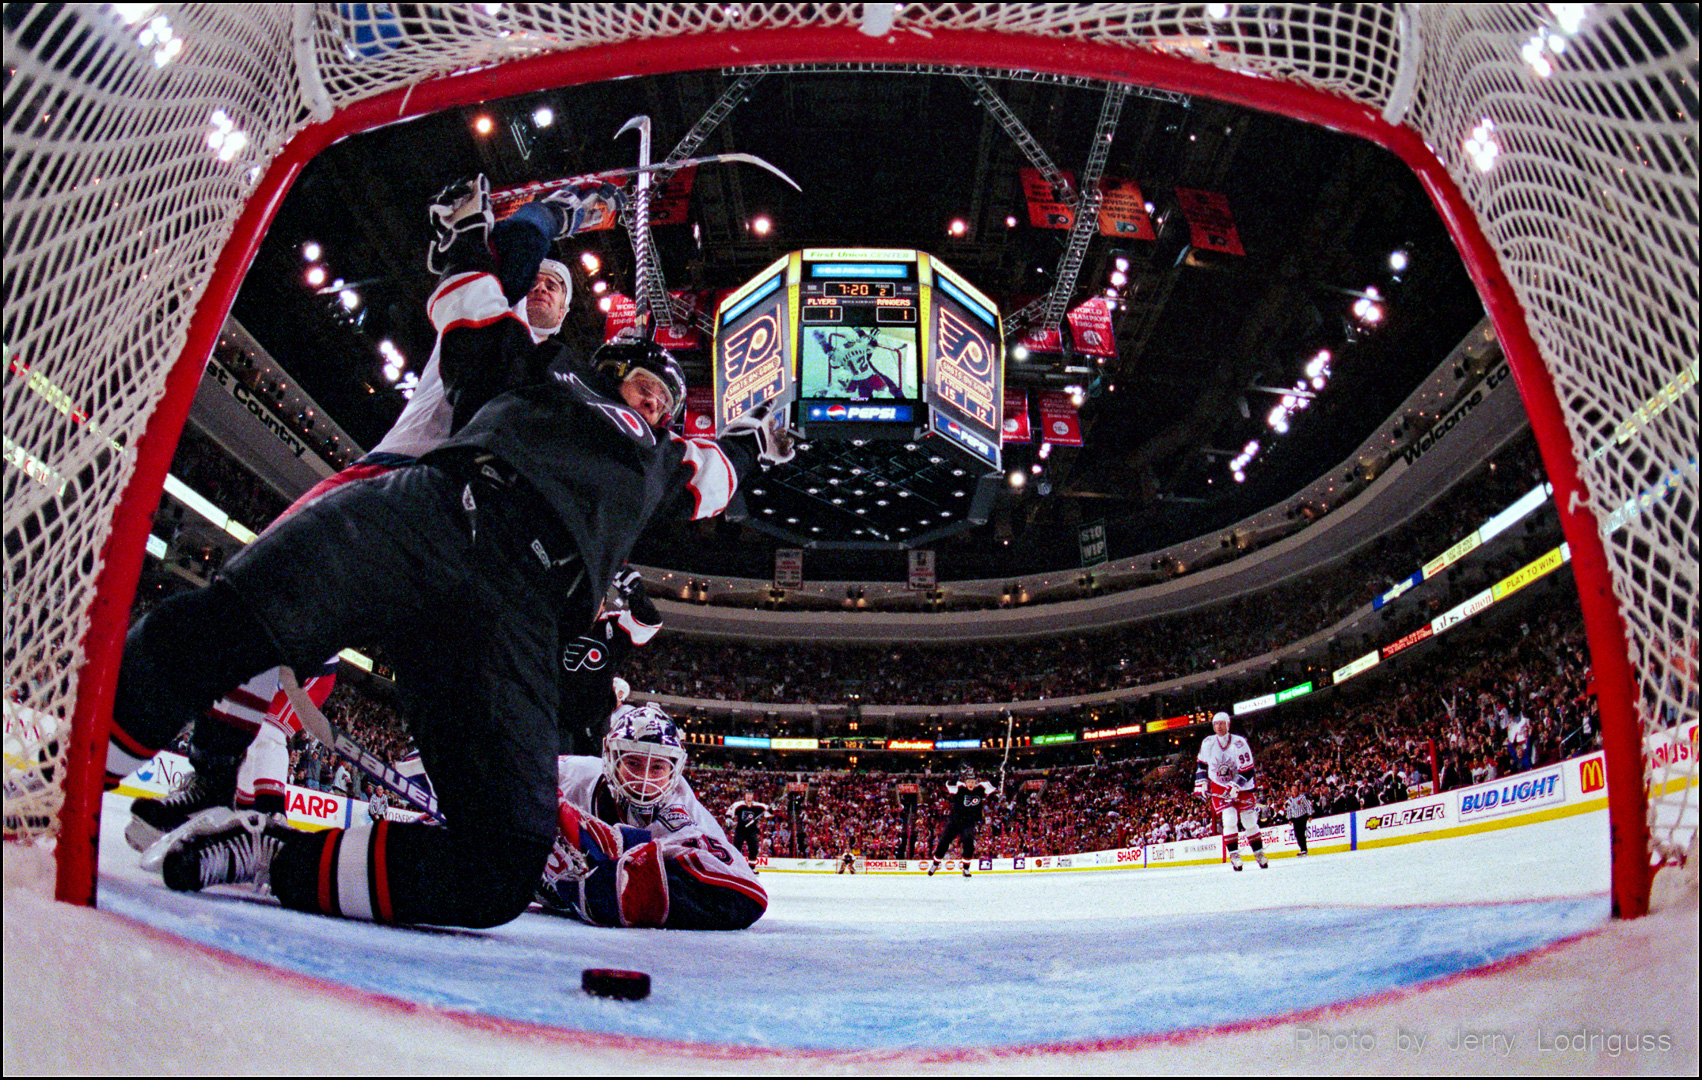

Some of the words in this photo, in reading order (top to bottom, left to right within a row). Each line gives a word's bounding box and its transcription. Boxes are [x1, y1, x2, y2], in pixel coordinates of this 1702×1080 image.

[839, 284, 868, 295] 7:20
[880, 288, 886, 296] 2
[763, 385, 774, 400] 12
[945, 386, 956, 400] 15
[732, 405, 743, 418] 15
[847, 407, 896, 419] PEPSI
[976, 406, 987, 421] 12
[1403, 390, 1483, 466] Welcome
[1486, 364, 1510, 390] to
[233, 381, 306, 458] Country
[1506, 574, 1525, 590] PLAY
[1527, 566, 1538, 577] TO
[1463, 595, 1492, 618] Canon
[1083, 731, 1098, 740] First
[1098, 729, 1117, 738] Union
[1116, 725, 1141, 736] CENTER
[889, 740, 932, 749] Budweiser
[1238, 752, 1251, 765] 99
[1460, 789, 1499, 814] BUD
[1501, 774, 1560, 806] LIGHT
[1381, 803, 1445, 830] BLAZER
[1312, 822, 1345, 837] Healthcare
[1117, 849, 1142, 862] SHARP
